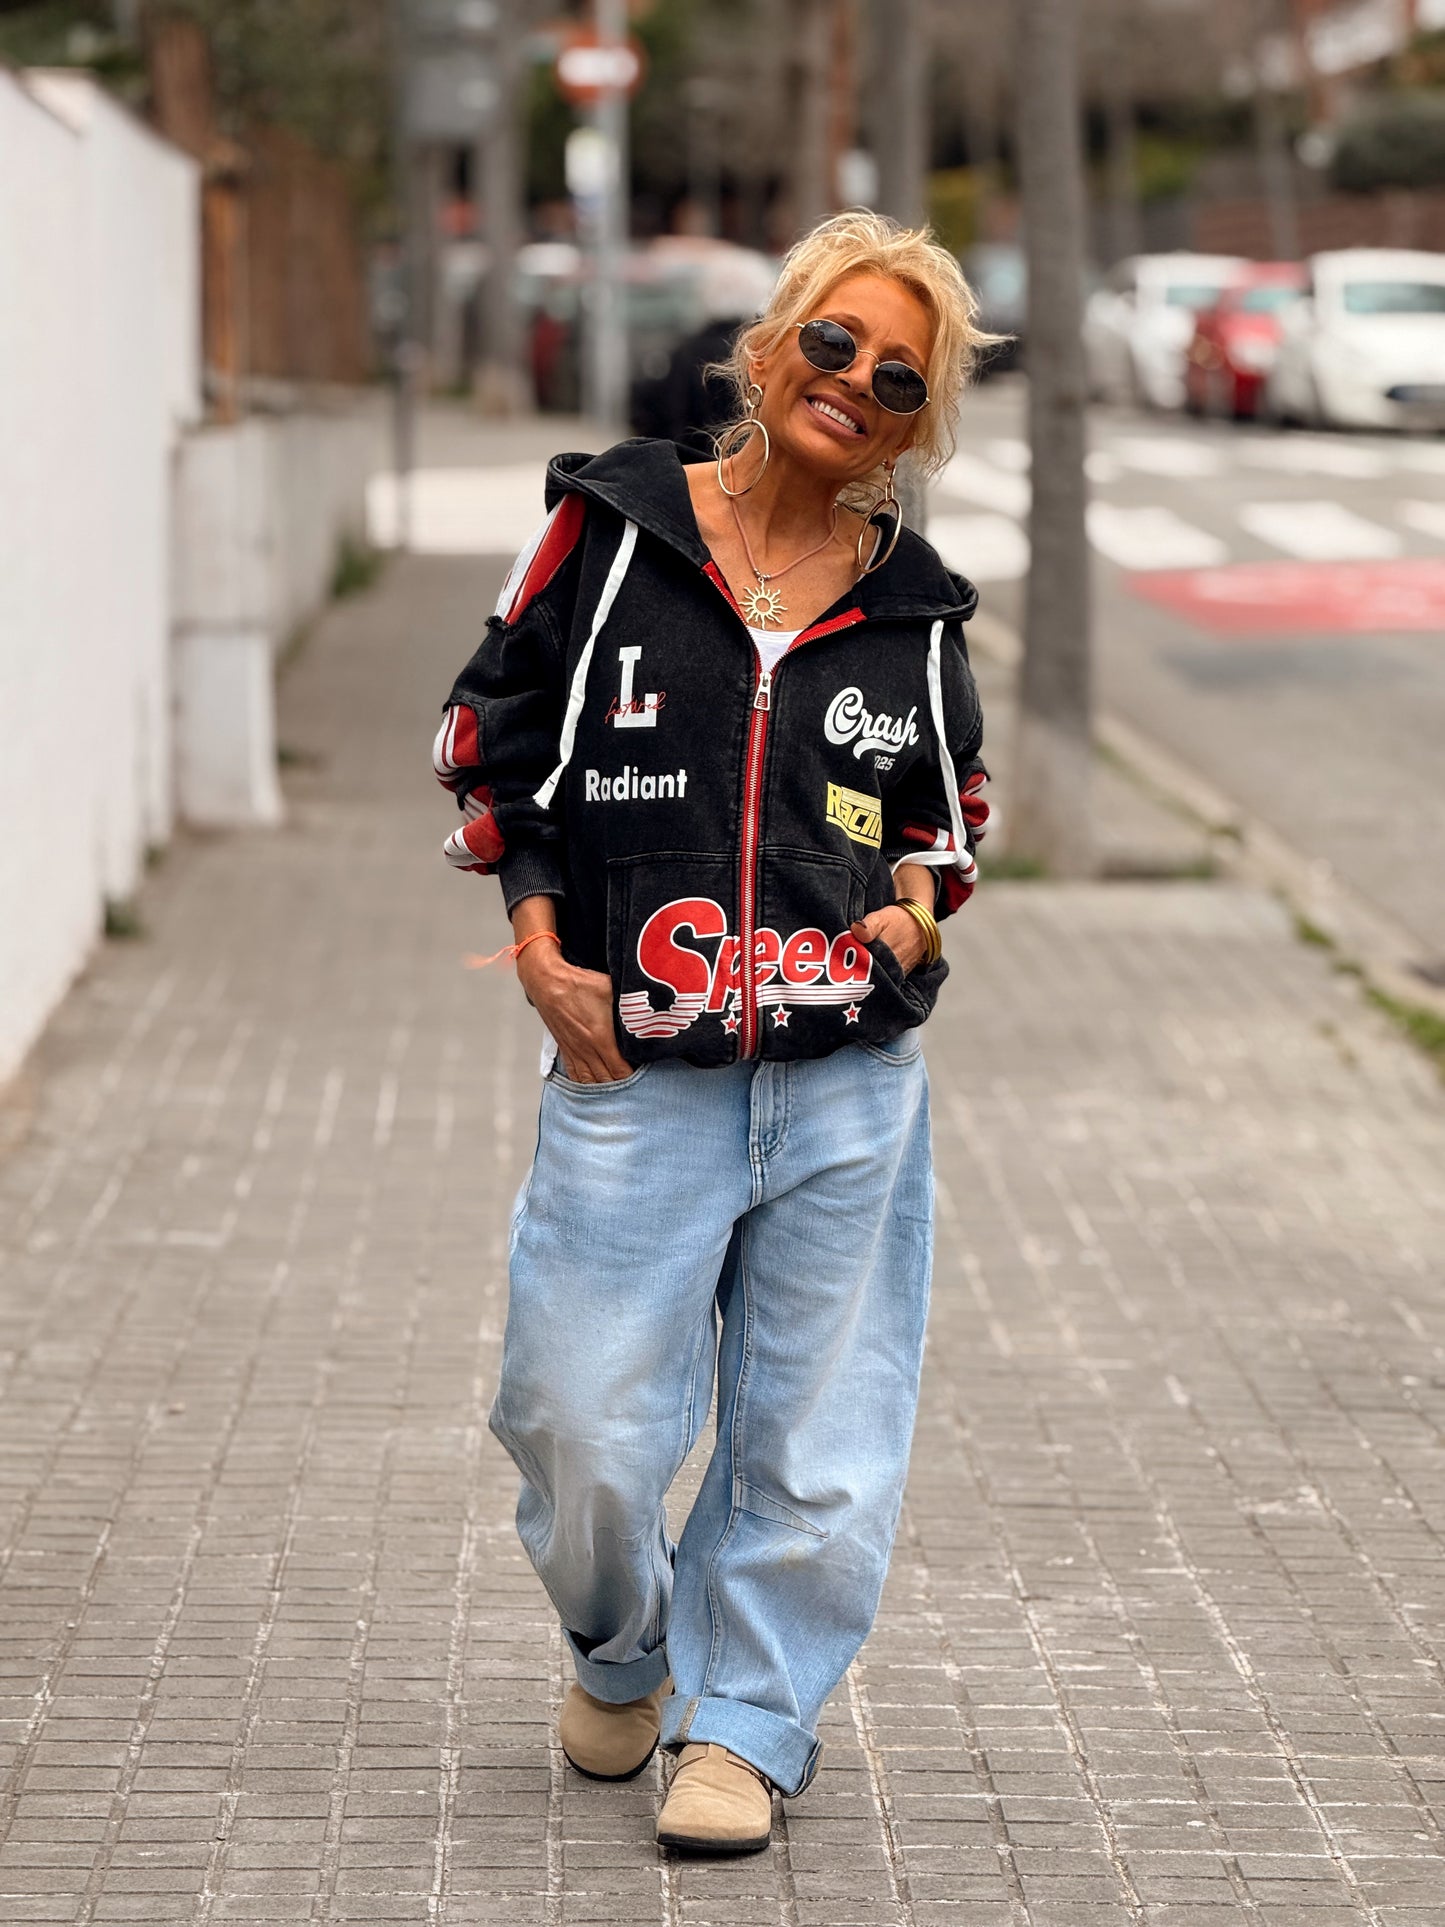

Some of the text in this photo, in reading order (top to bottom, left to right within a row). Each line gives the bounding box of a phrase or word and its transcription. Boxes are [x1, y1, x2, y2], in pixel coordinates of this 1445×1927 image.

[614, 645, 658, 728] L
[823, 686, 920, 760] Crash
[585, 765, 688, 802] Radiant
